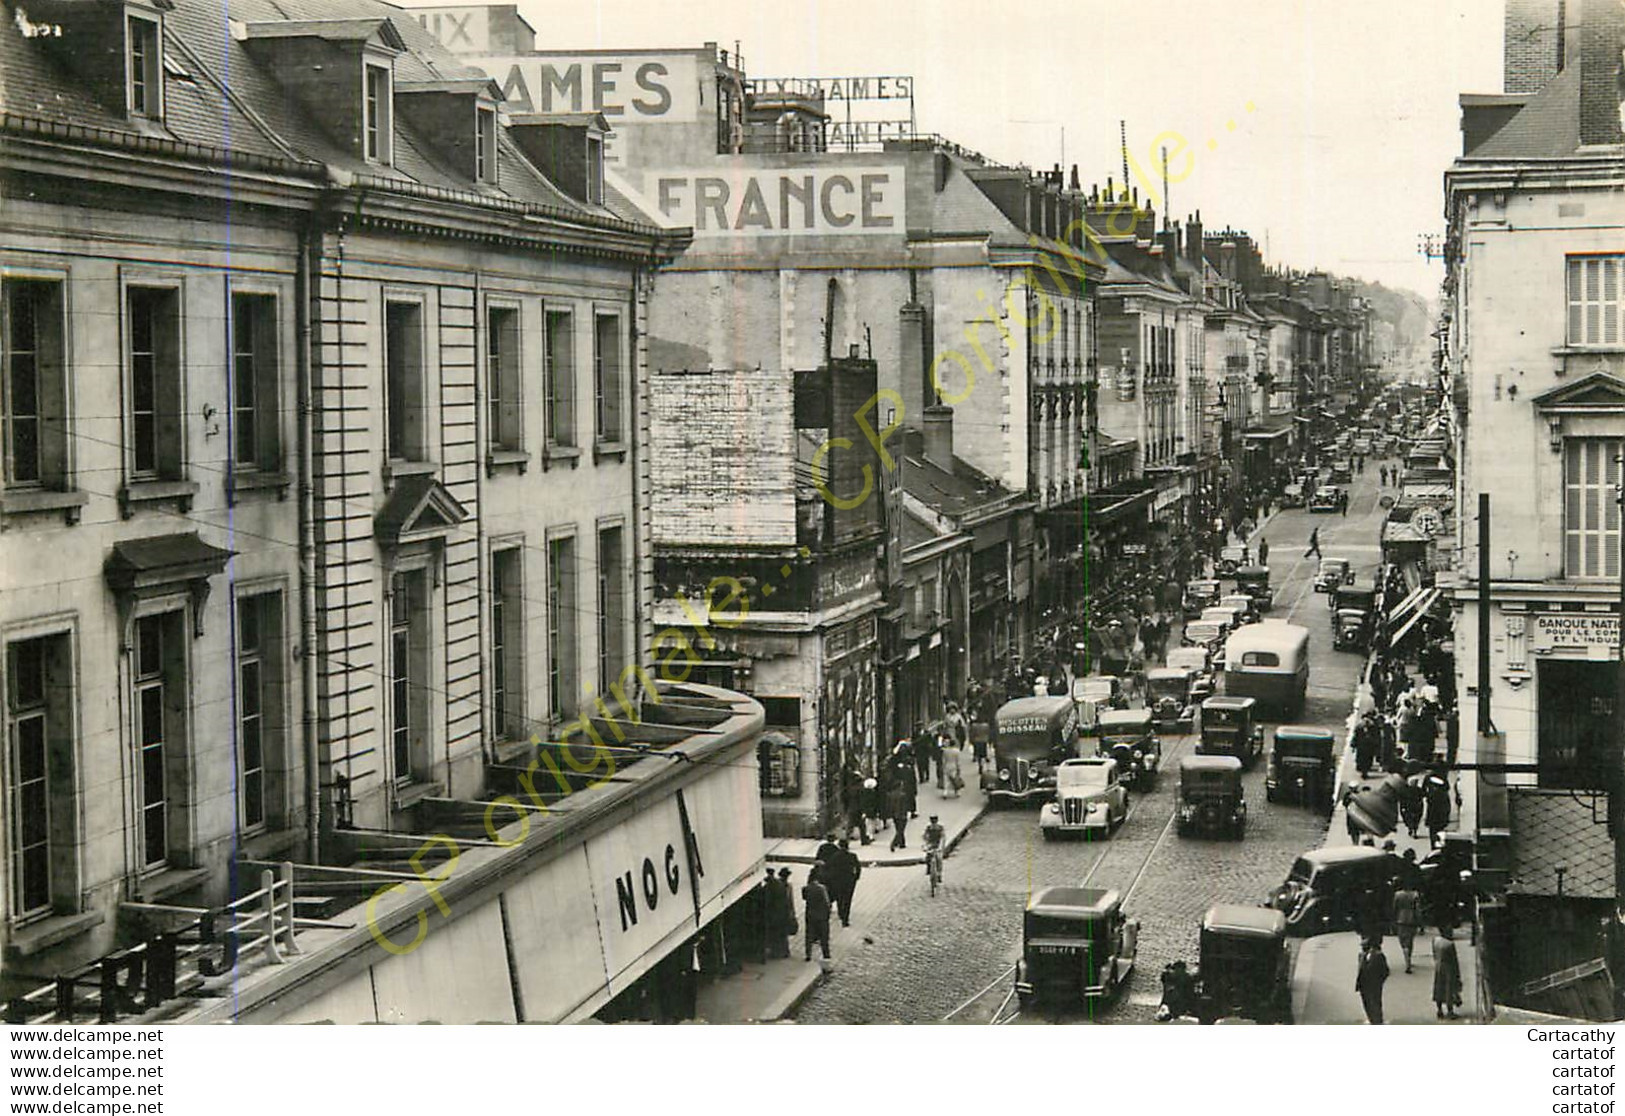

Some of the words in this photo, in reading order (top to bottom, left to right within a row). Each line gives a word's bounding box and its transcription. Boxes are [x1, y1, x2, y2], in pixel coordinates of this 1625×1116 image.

[466, 62, 672, 116] AMES
[658, 174, 894, 230] FRANCE
[1539, 619, 1588, 629] BANQUE
[999, 725, 1047, 734] BOISSEAU
